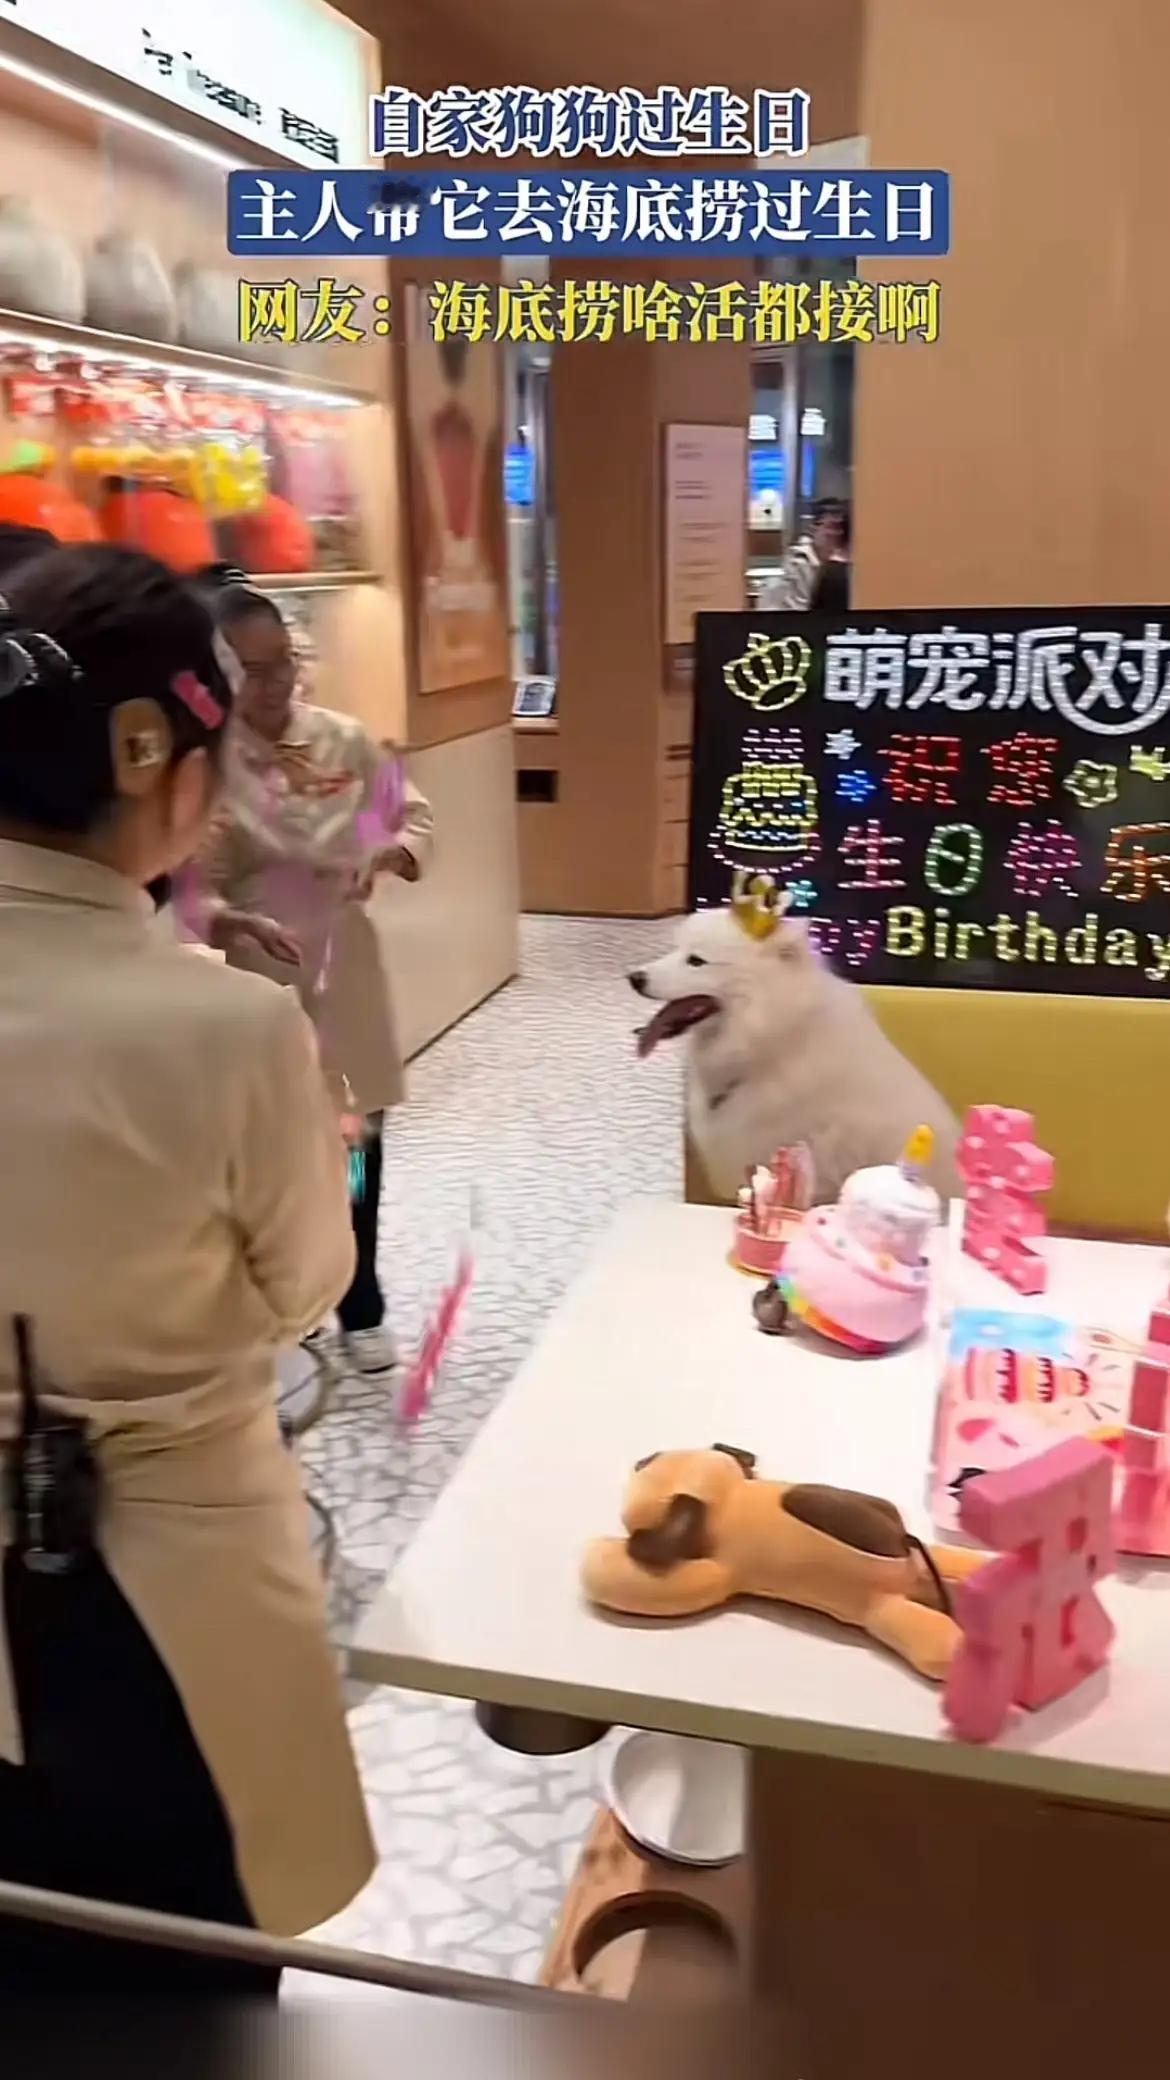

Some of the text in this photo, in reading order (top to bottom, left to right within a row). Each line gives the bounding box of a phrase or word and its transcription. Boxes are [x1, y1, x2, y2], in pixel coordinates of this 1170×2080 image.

[823, 622, 1170, 736] 萌宠派对
[837, 818, 1170, 903] 生日快乐
[885, 905, 1170, 982] Birthday
